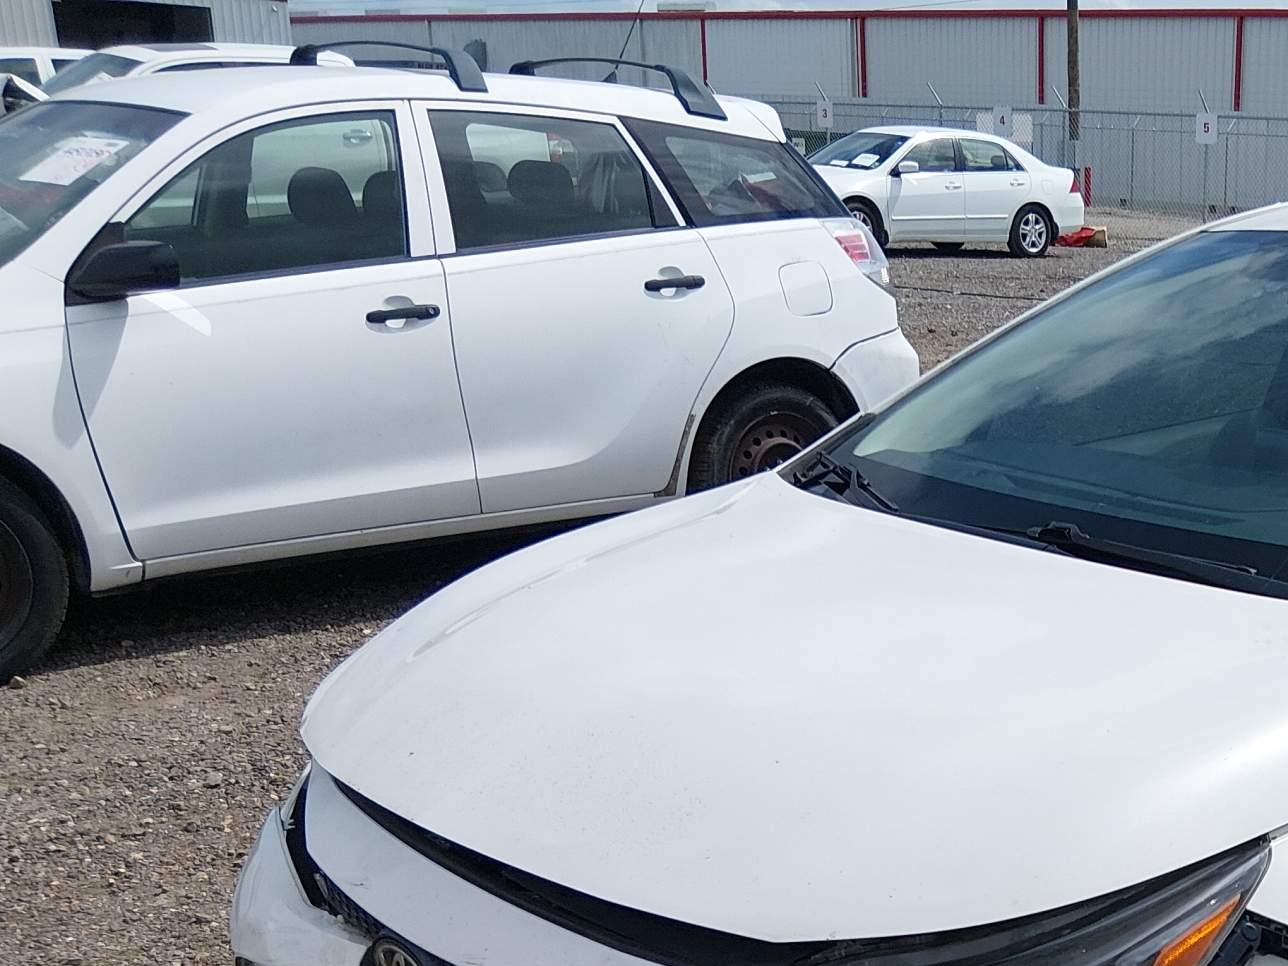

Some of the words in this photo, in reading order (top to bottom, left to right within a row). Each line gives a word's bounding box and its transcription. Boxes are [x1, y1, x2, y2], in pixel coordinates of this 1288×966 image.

[822, 108, 828, 119] 3
[999, 115, 1006, 126] 4
[1203, 122, 1210, 134] 5
